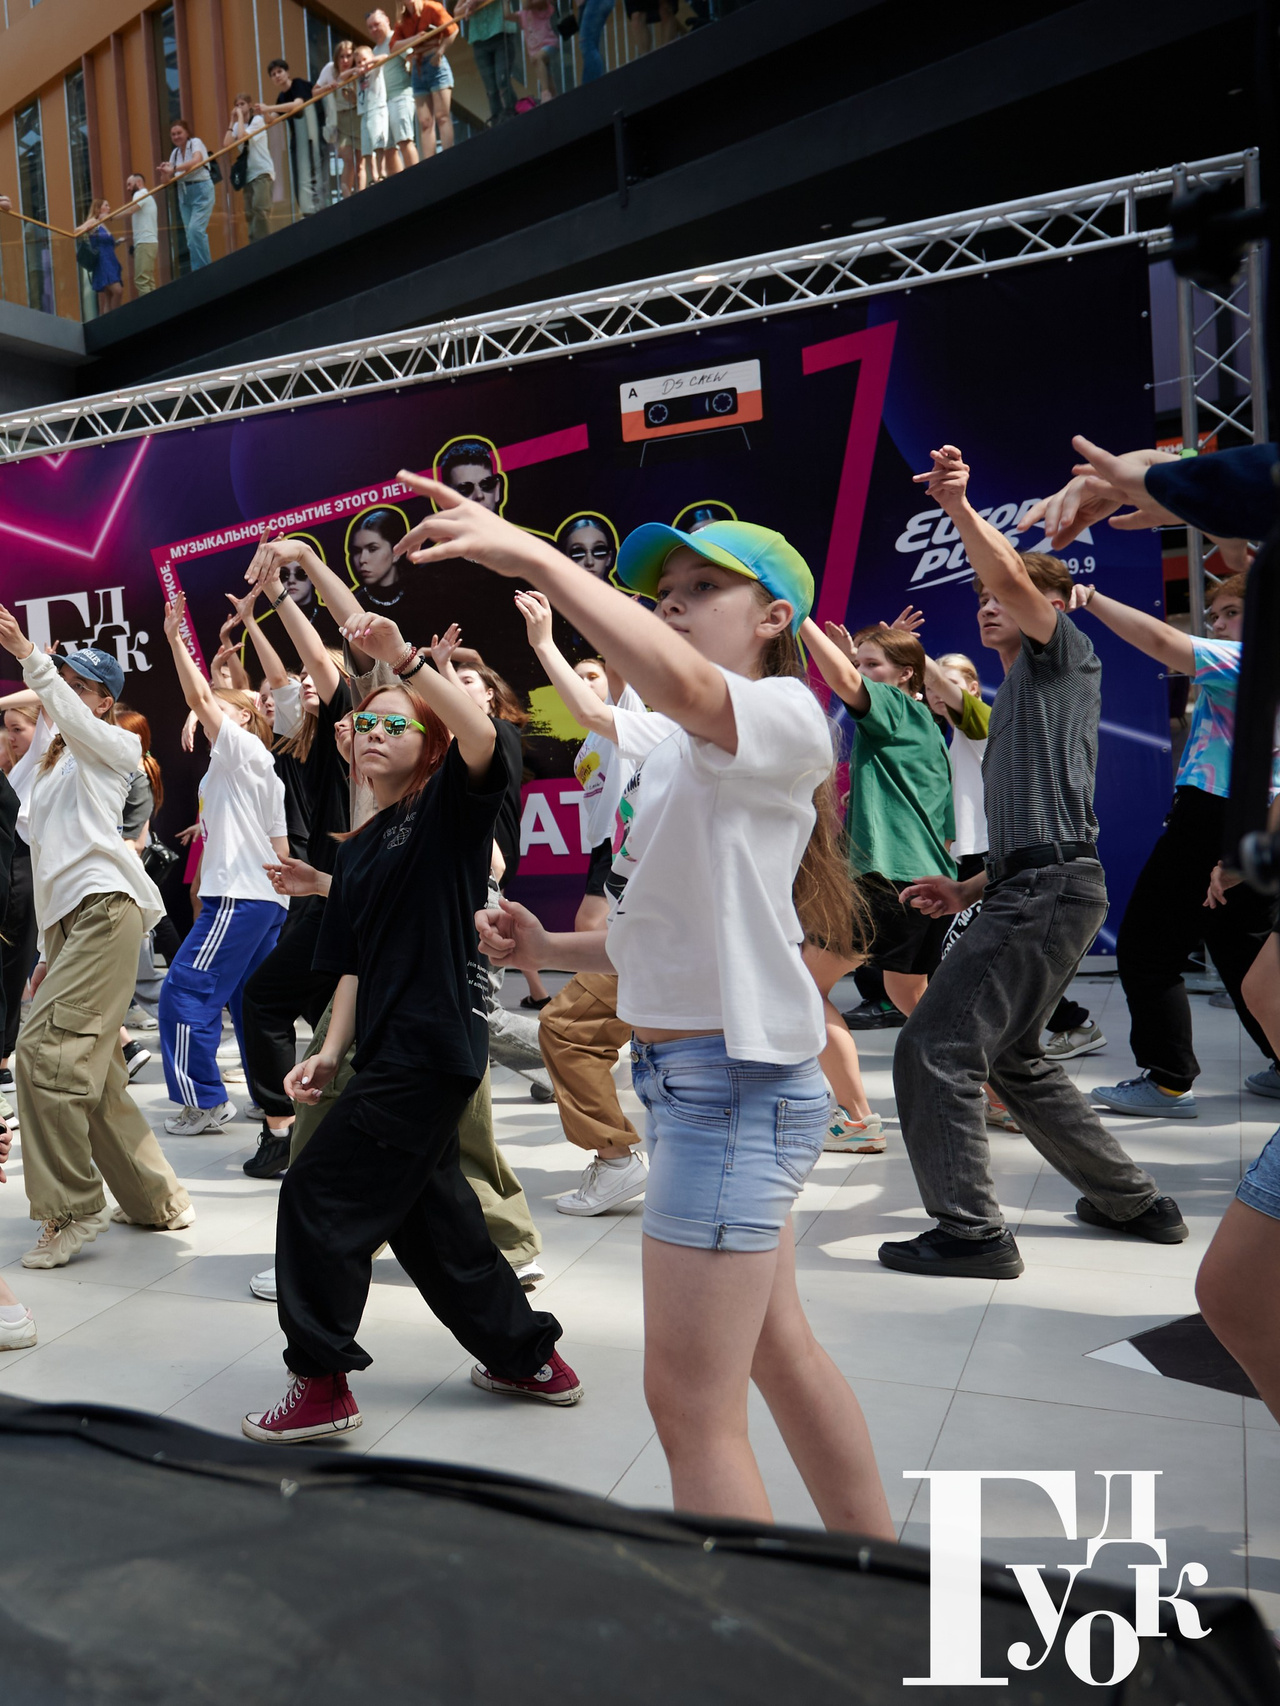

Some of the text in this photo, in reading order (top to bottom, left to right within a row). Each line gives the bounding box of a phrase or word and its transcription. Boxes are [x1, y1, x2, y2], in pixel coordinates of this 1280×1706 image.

[628, 388, 638, 399] A
[170, 482, 413, 559] МУЗЫКАЛЬНОЕ СОБЫТИЕ ЭТОГО ЛЕТ
